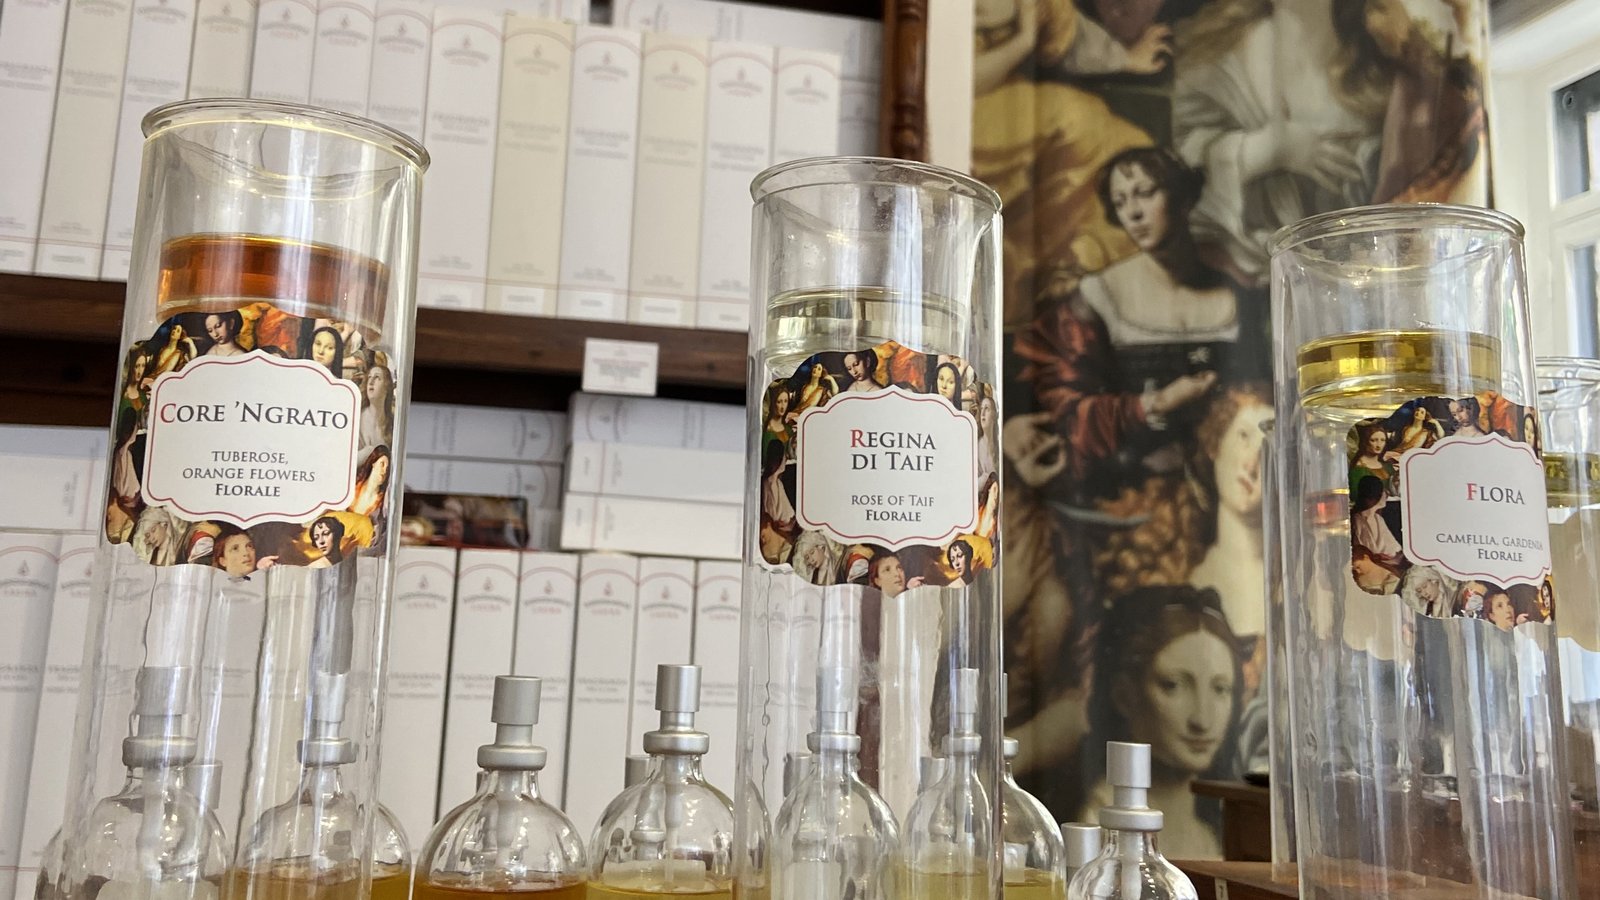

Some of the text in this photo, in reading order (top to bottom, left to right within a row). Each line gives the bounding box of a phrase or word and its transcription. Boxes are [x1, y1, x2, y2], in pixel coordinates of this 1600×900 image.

[160, 402, 226, 424] CORE
[850, 429, 936, 449] REGINA
[211, 450, 289, 465] TUBEROSE,
[852, 452, 934, 471] DI TAIF
[182, 467, 316, 482] ORANGE FLOWERS
[215, 483, 281, 497] FLORALE
[1466, 483, 1526, 505] FLORA
[851, 494, 935, 507] ROSE OF TAIF
[865, 509, 922, 522] FLORALE
[1477, 548, 1524, 562] FLORALE
